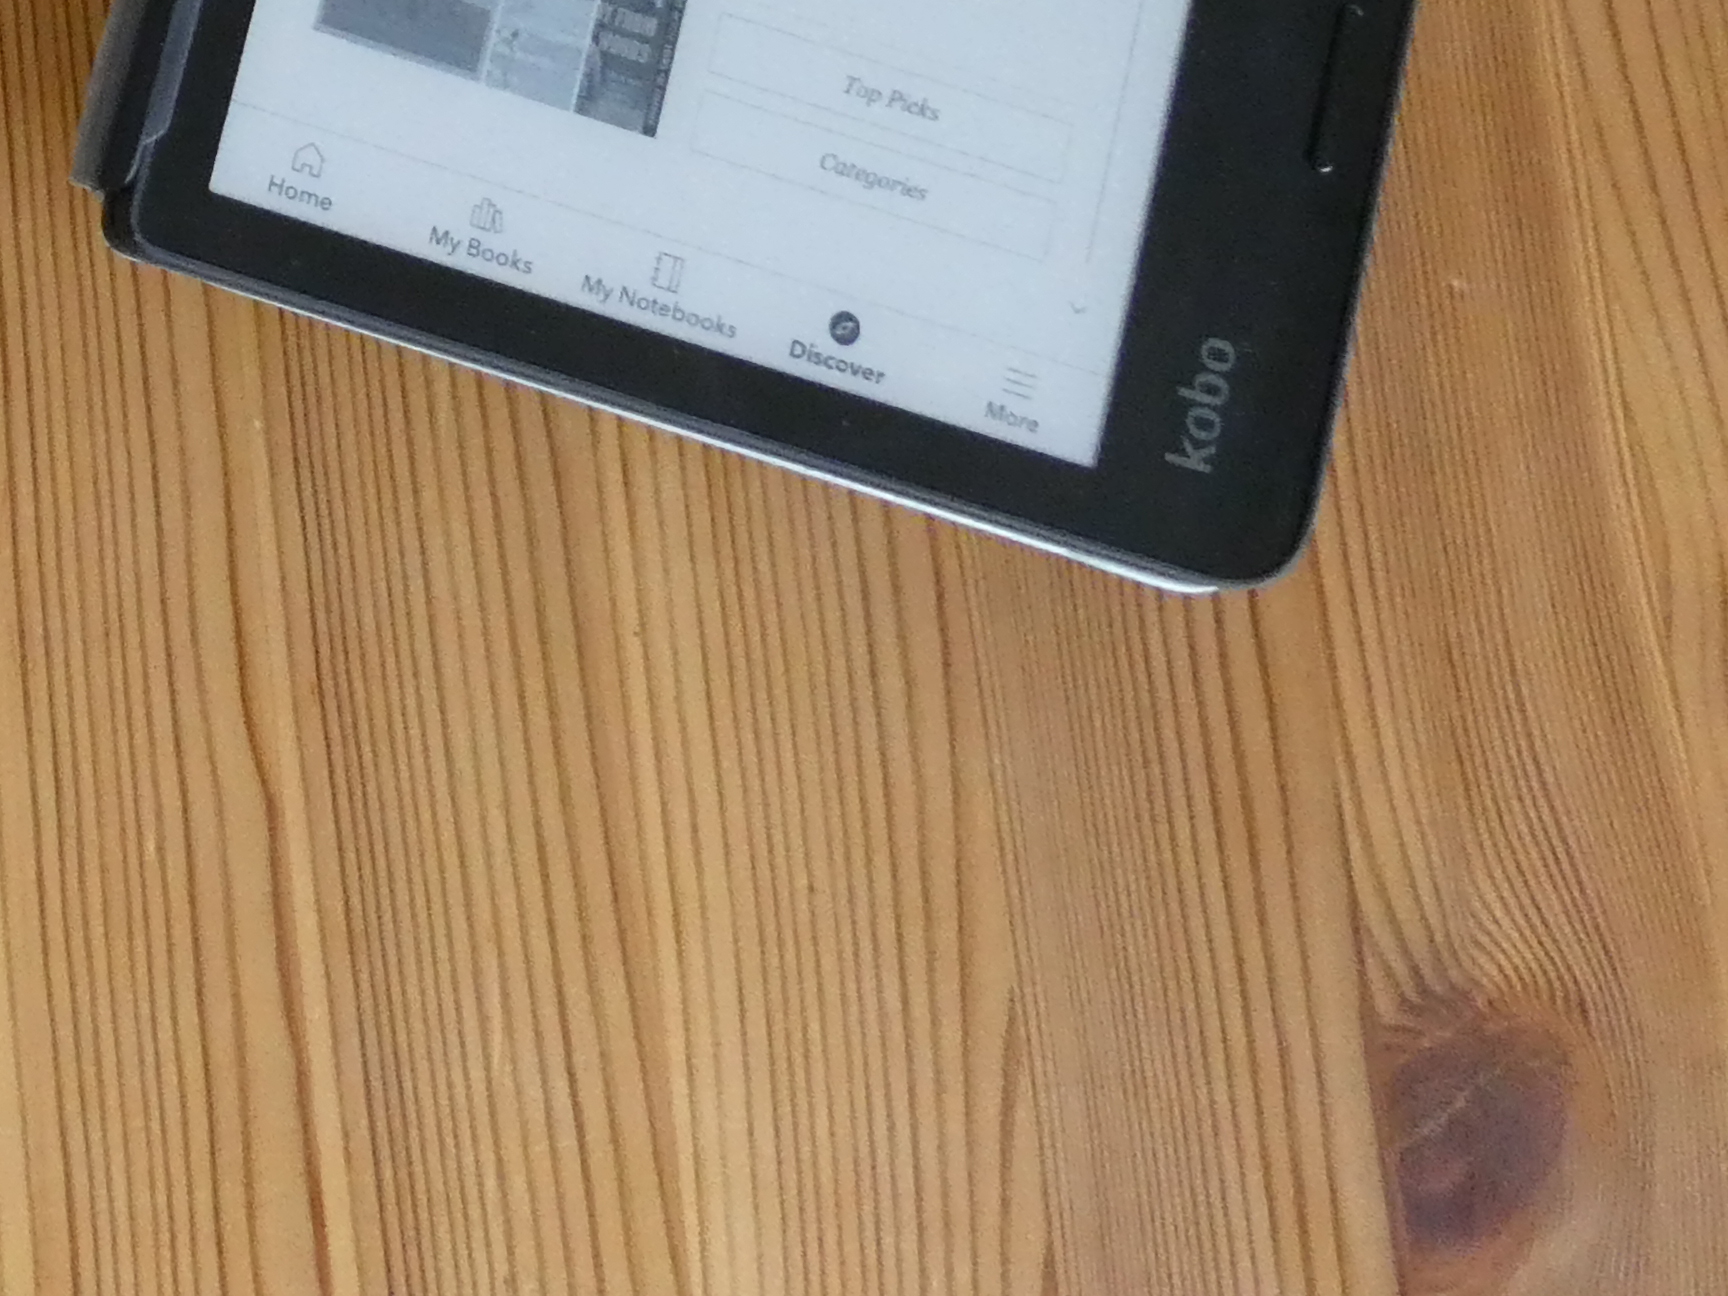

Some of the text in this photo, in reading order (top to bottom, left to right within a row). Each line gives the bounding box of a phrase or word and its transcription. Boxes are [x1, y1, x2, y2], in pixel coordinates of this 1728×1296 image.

[843, 74, 942, 123] Top Picks
[818, 149, 930, 203] Categories
[267, 175, 1040, 435] Home My Books My Notebooks Discover More
[1162, 336, 1237, 474] kobo
